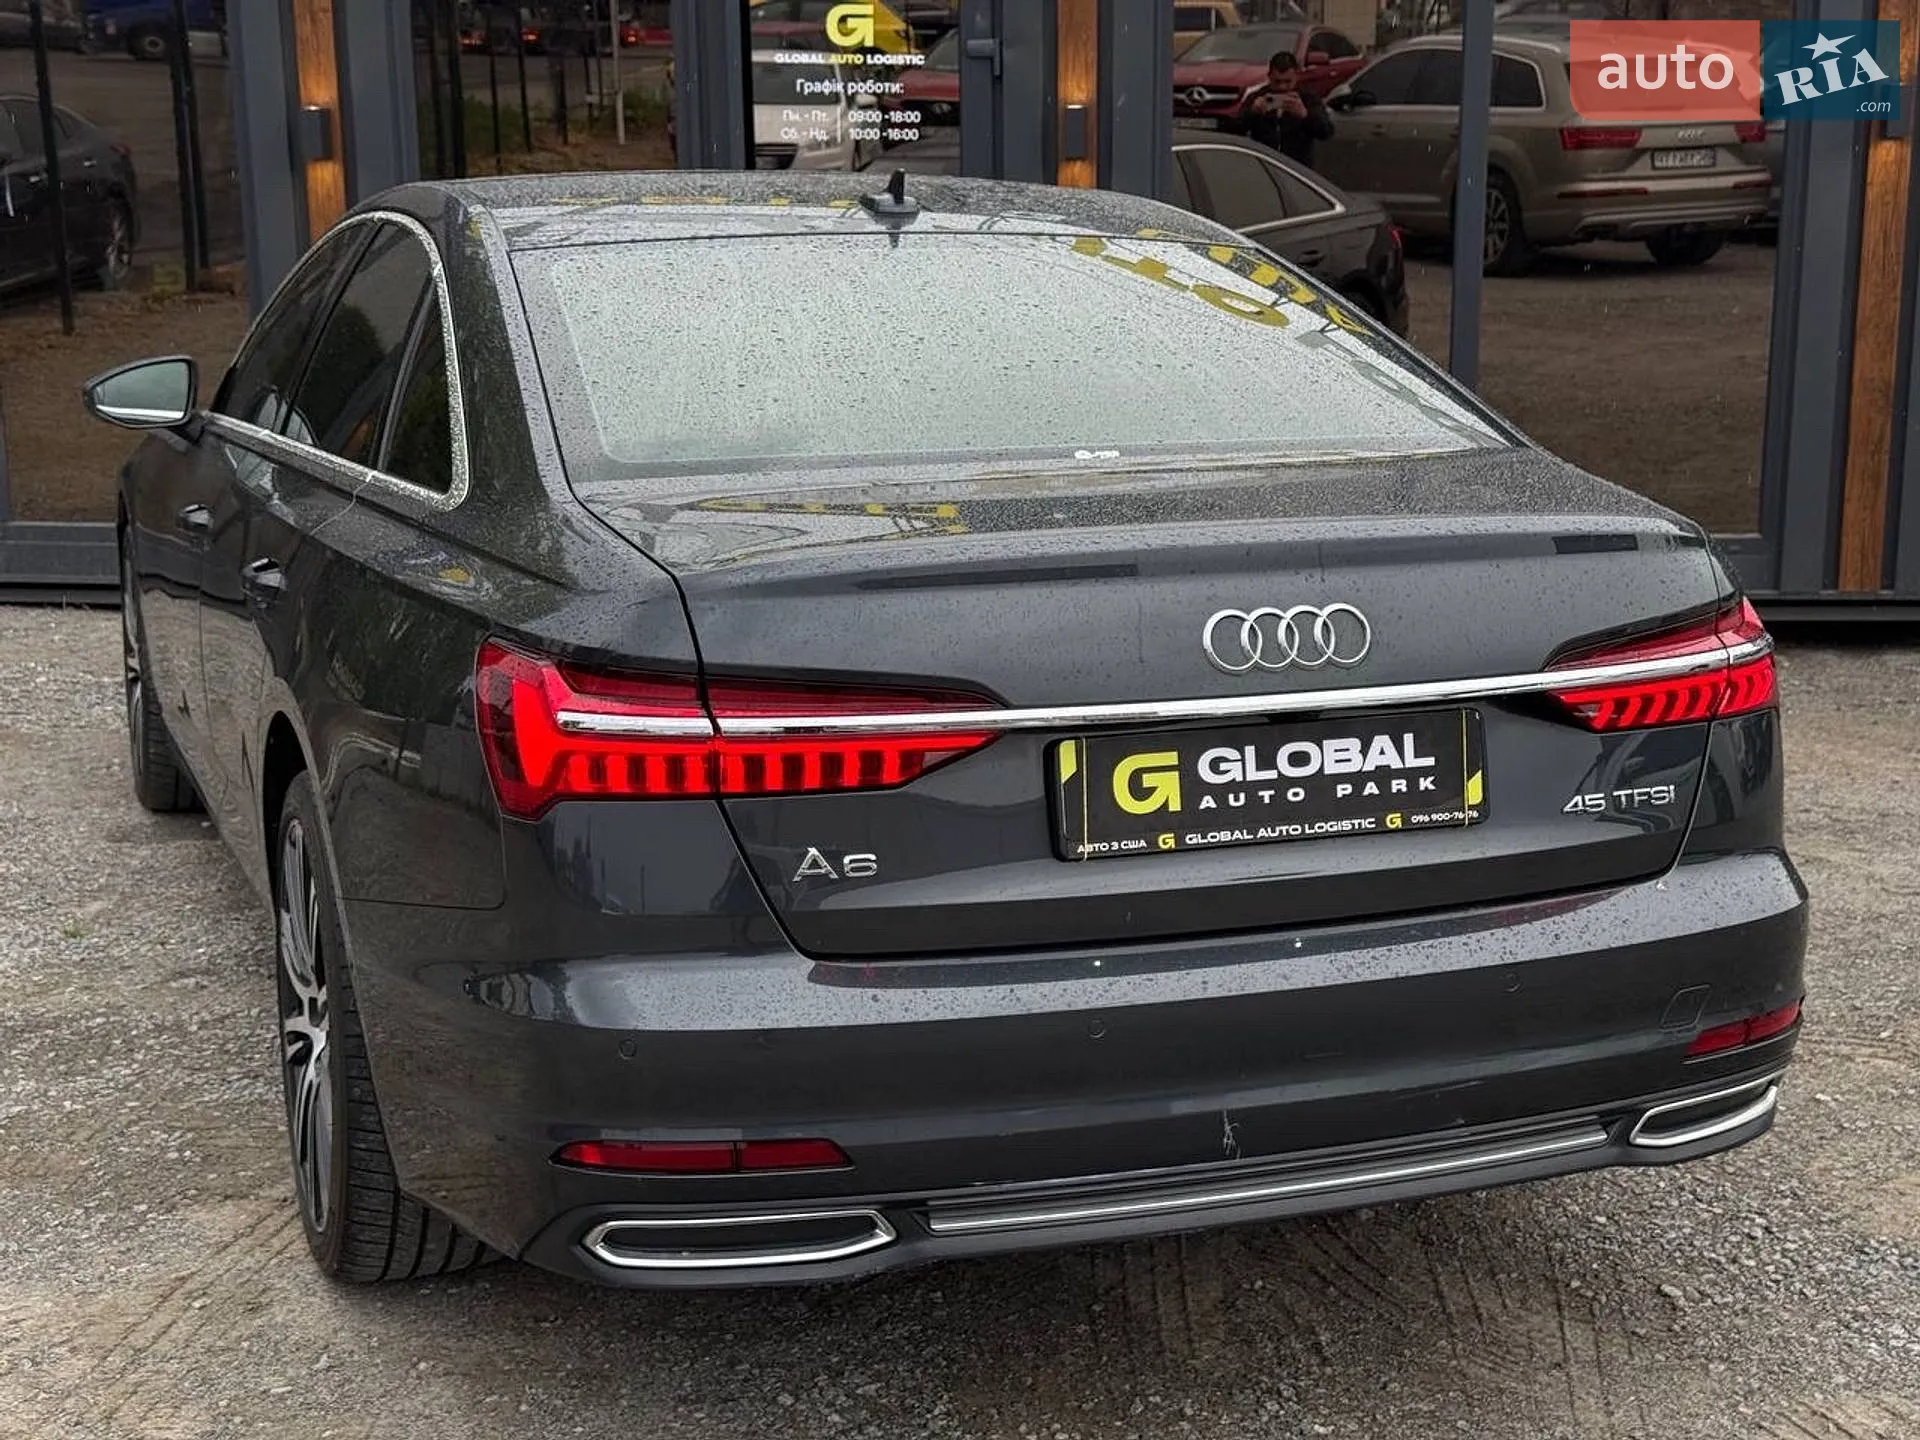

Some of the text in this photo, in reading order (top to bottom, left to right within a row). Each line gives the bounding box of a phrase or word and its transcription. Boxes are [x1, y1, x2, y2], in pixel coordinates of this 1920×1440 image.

[774, 53, 926, 65] GLOBAL AUTO LOGISTIC
[796, 79, 905, 95] Графік роботи:
[848, 110, 882, 123] 09:00
[849, 127, 880, 140] 10:00
[1197, 733, 1436, 784] GLOBAL
[1198, 775, 1437, 811] AUTO PARK
[1563, 785, 1675, 813] 45 TFSI
[1411, 814, 1430, 824] 096
[1185, 818, 1376, 845] GLOBAL AUTO LOGISTIC
[792, 847, 878, 882] A6
